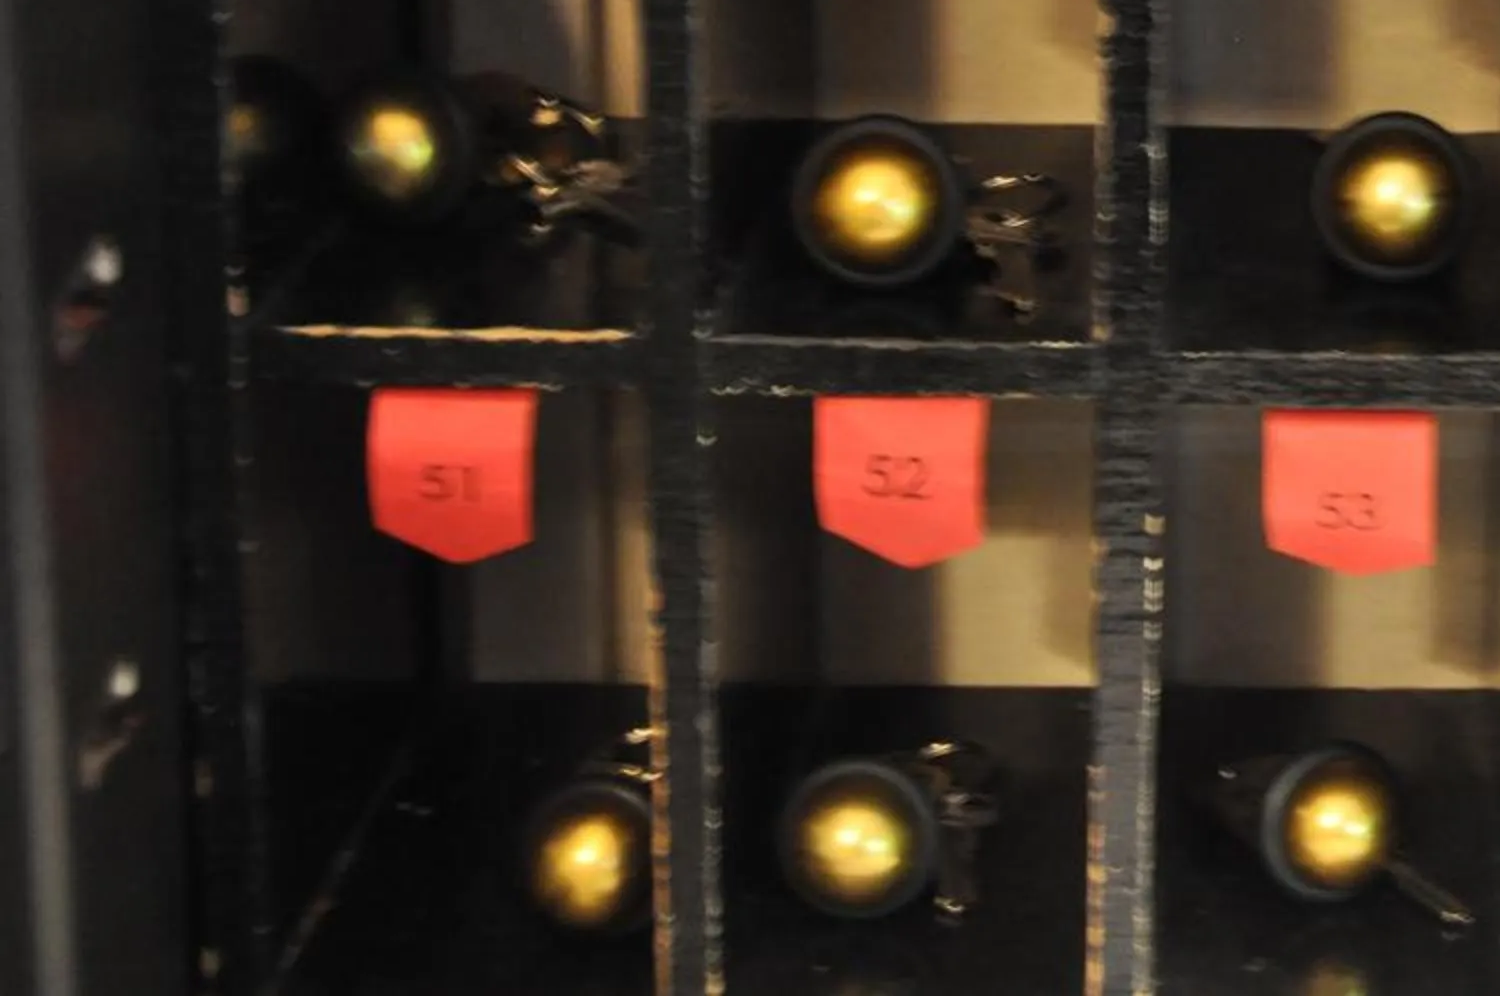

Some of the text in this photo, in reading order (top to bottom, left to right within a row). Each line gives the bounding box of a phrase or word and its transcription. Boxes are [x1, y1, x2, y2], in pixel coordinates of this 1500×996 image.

[418, 463, 484, 504] 51
[860, 453, 935, 501] 52
[1314, 491, 1387, 532] 53
